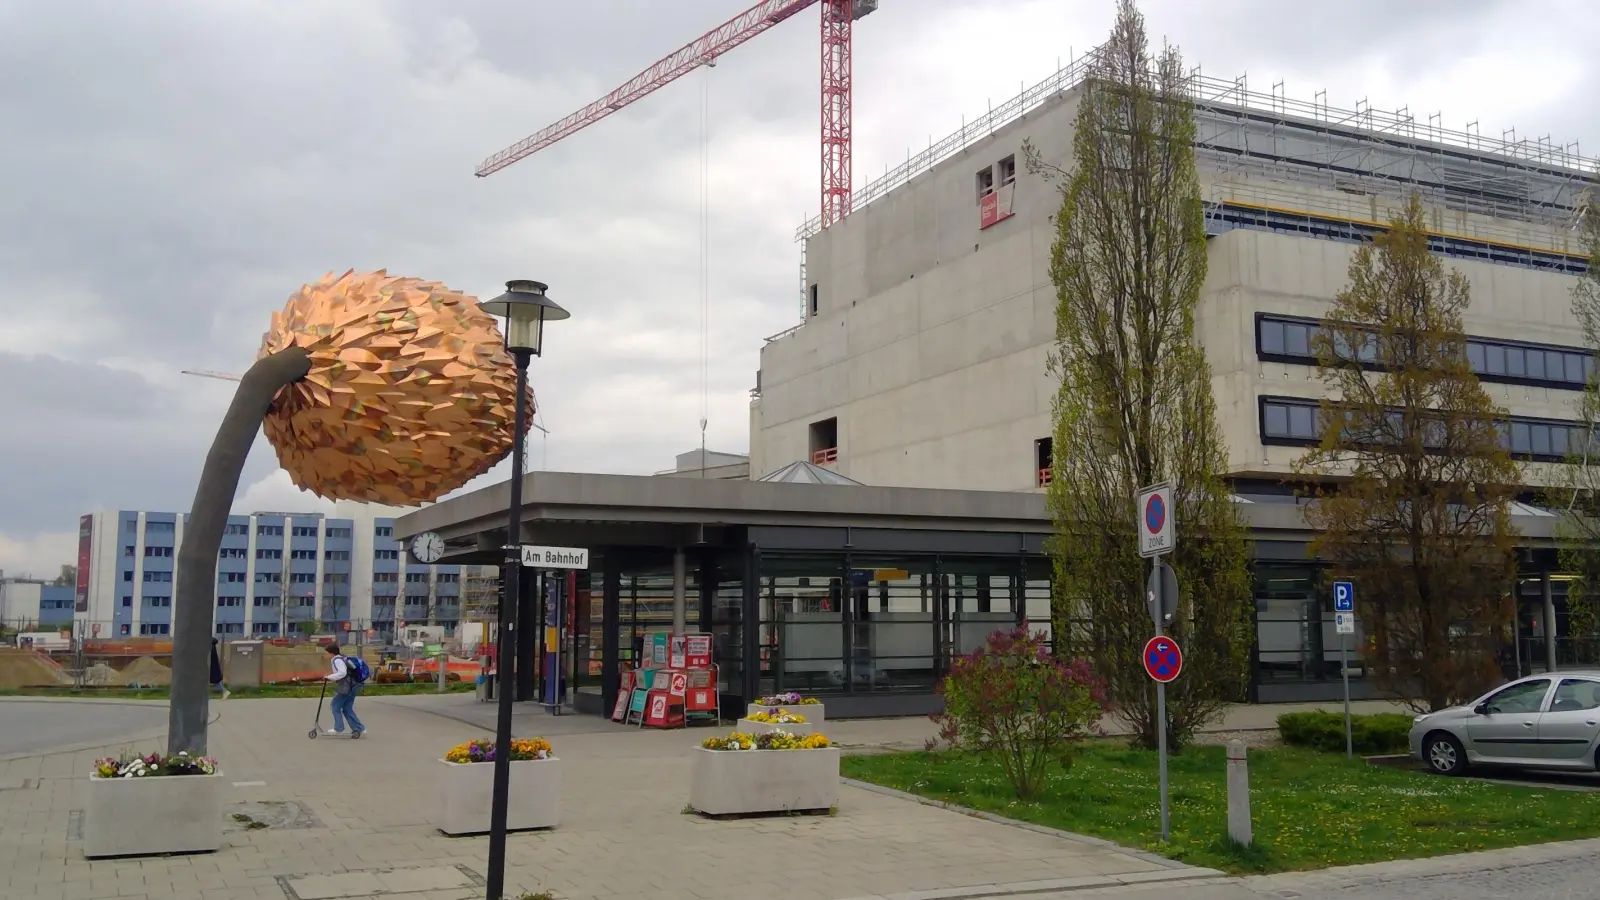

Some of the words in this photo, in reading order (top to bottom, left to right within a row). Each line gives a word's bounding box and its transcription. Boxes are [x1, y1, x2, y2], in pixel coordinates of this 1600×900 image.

[1148, 535, 1165, 548] ZONE
[525, 549, 541, 563] Am
[545, 550, 584, 565] Bahnhof
[1337, 585, 1348, 608] P
